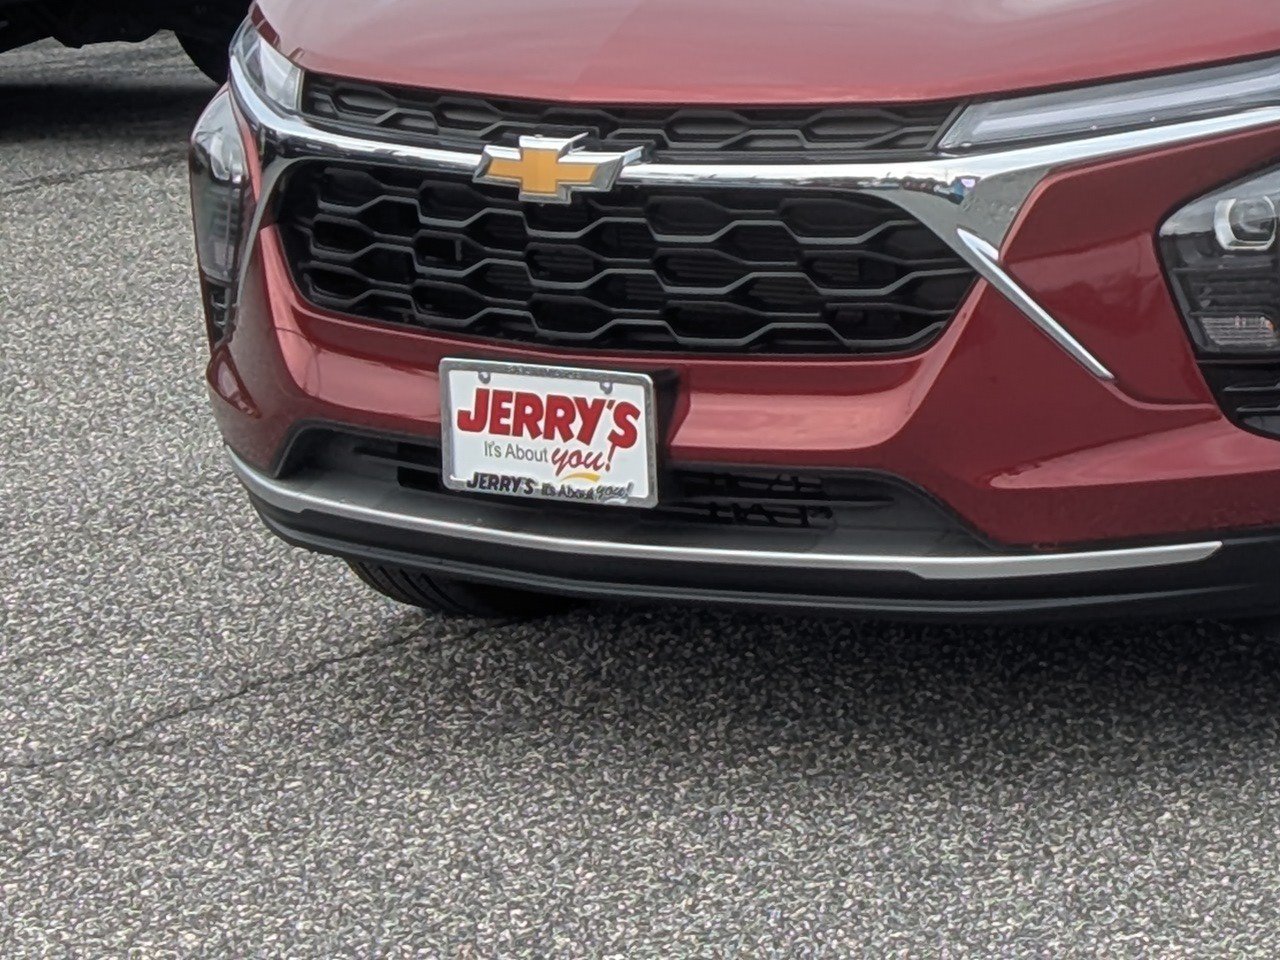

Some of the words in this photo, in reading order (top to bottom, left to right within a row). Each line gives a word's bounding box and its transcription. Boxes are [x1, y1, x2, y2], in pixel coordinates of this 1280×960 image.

[456, 387, 641, 449] JERRY'S
[484, 441, 502, 459] It's
[505, 442, 549, 463] About
[551, 443, 616, 476] you!
[466, 471, 537, 495] JERRY'S
